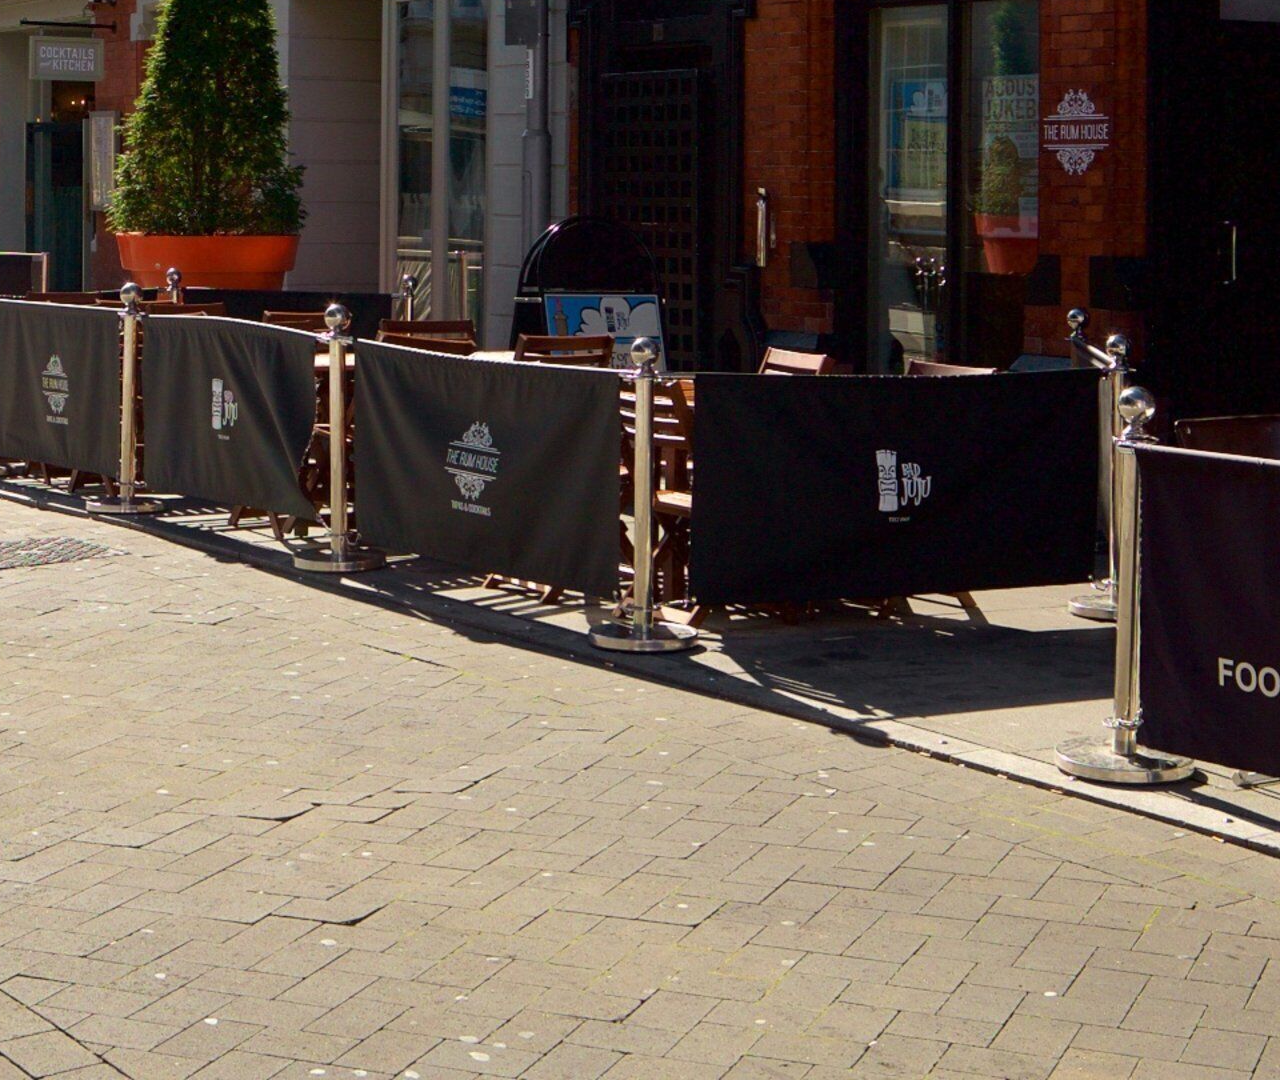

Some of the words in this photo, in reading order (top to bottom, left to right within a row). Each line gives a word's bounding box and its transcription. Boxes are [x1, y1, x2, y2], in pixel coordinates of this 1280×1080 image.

[40, 46, 95, 60] COCKTAILS
[52, 59, 95, 71] KITCHEN
[1043, 124, 1059, 141] THE
[1060, 124, 1079, 140] RUM
[1081, 123, 1109, 140] HOUSE
[446, 449, 460, 464] THE
[460, 452, 476, 468] RUM
[476, 455, 499, 473] HOUSE
[900, 462, 921, 478] BAD
